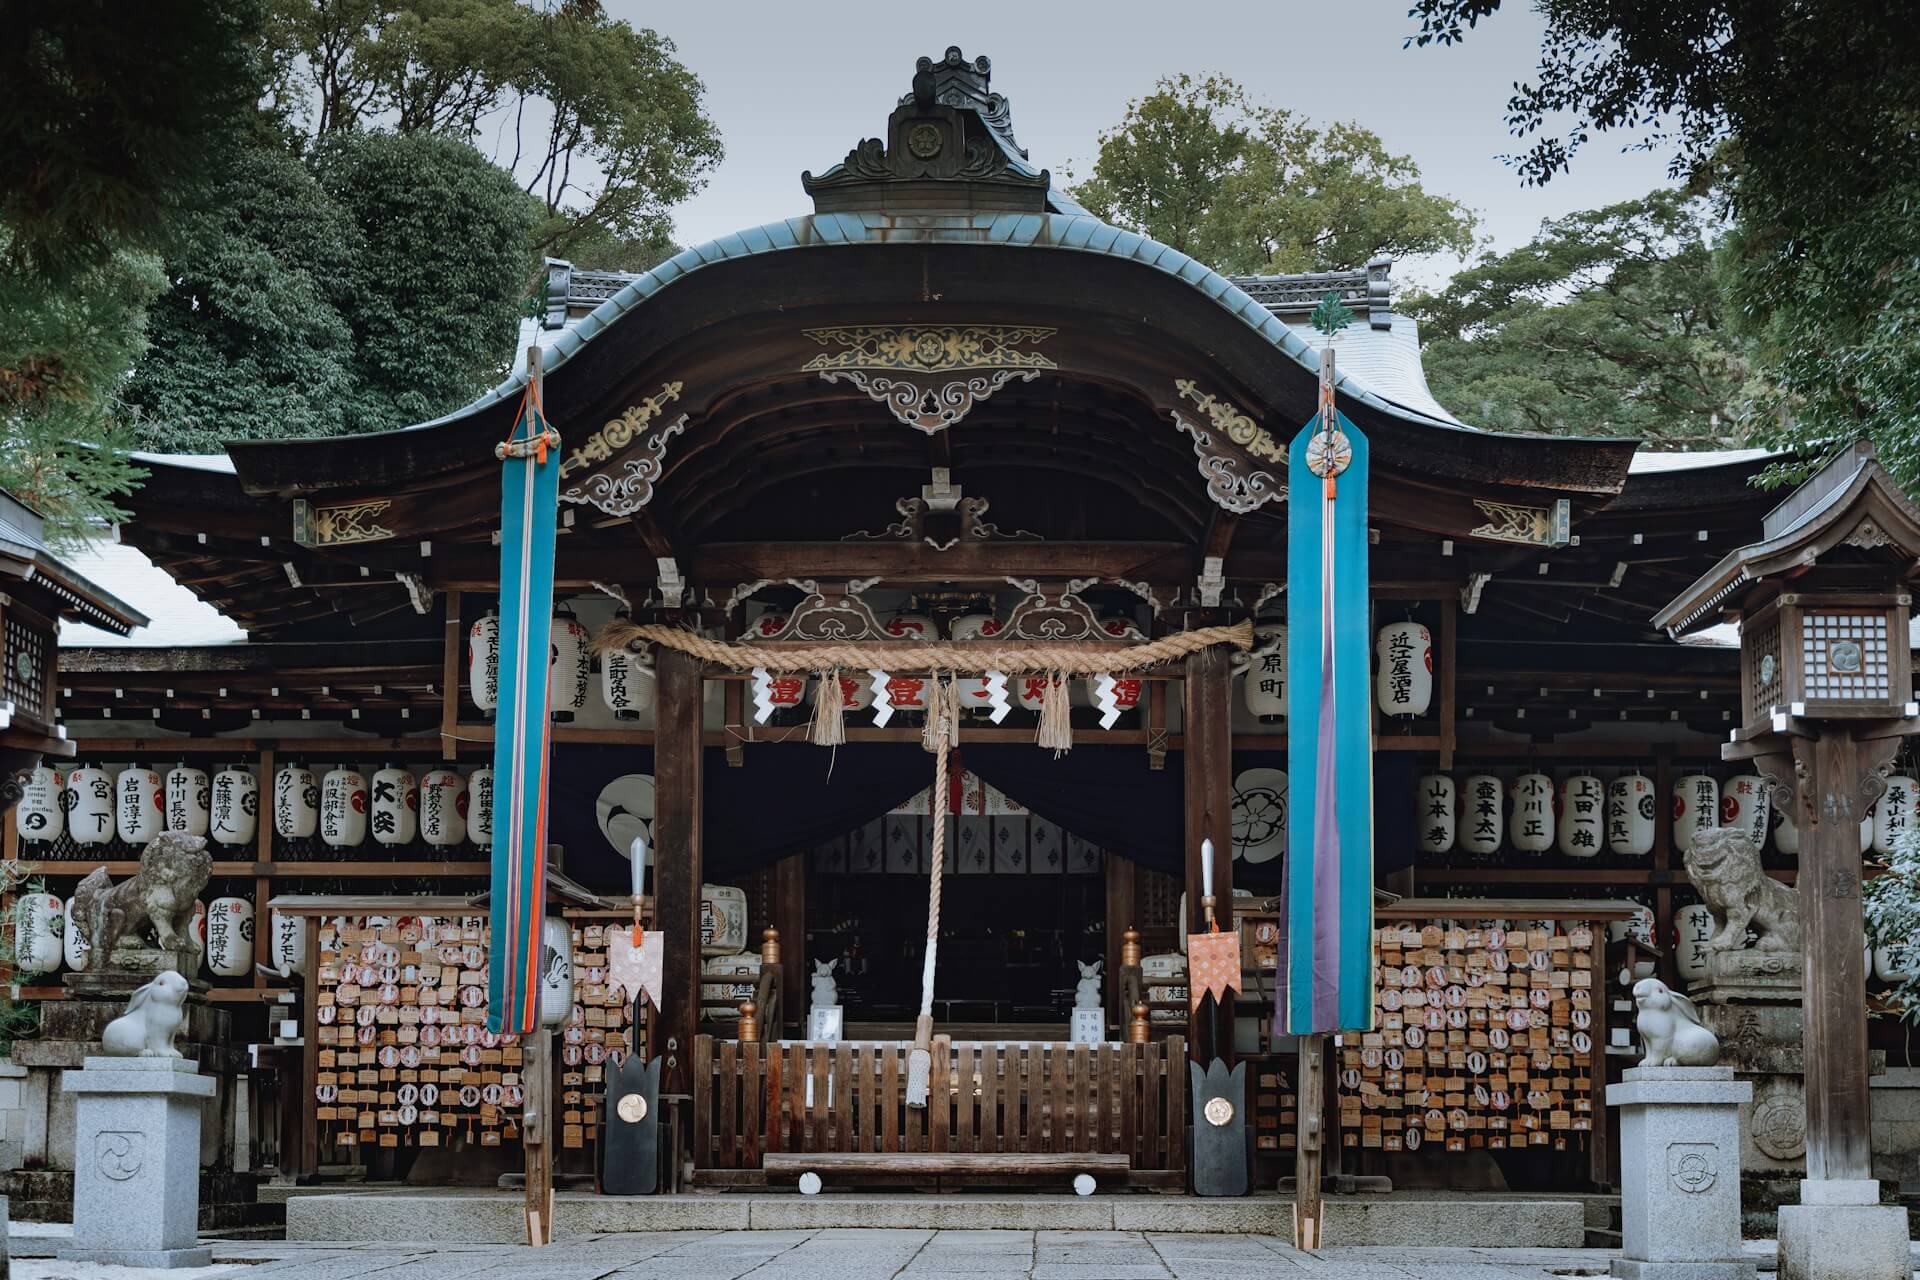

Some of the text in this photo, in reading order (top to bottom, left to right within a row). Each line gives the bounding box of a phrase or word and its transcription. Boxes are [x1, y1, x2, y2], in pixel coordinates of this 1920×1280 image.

[1389, 631, 1416, 704] 近江屋酒店
[89, 777, 110, 833] 宮下
[122, 777, 142, 835] 岩田淳子
[170, 772, 189, 831] 中川長治
[373, 780, 396, 834] 大安
[1425, 780, 1449, 846] 山本孝
[1521, 778, 1545, 837] 小川正
[1571, 780, 1596, 847] 上田一雄
[1610, 781, 1630, 845] 梶谷真一
[210, 903, 231, 969] 柴田博史
